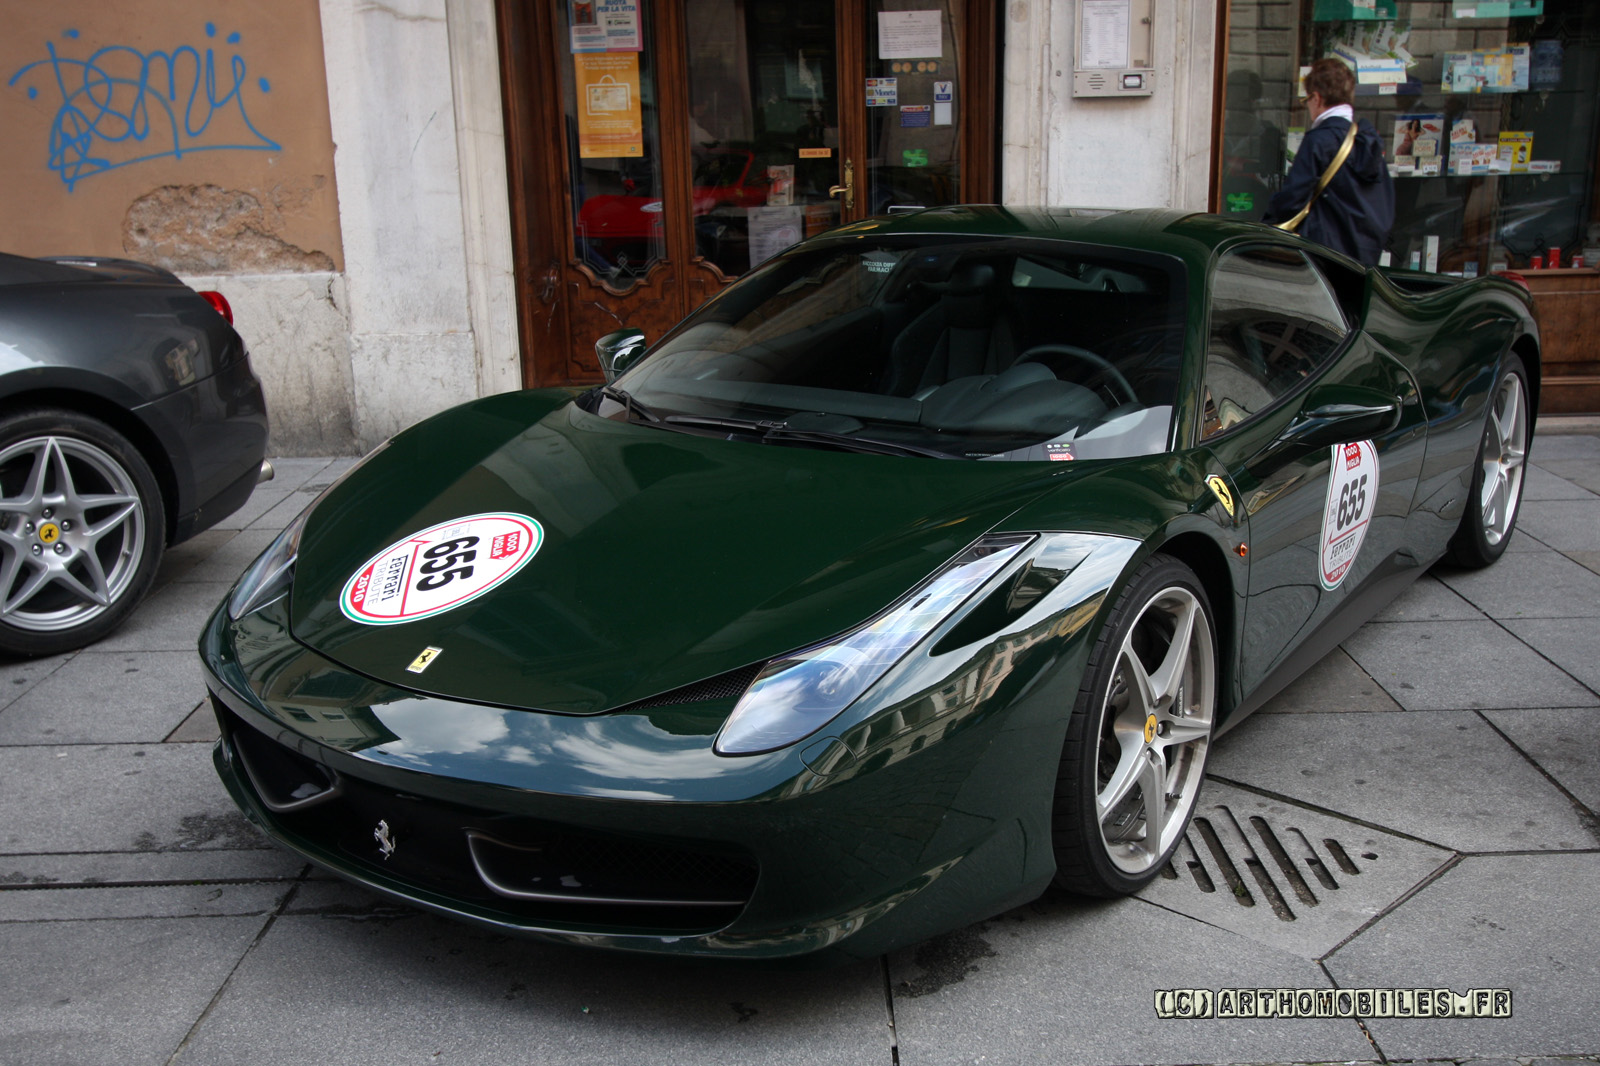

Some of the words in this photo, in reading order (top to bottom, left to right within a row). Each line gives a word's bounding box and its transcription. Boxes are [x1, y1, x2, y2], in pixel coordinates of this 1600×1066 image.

[1346, 445, 1358, 456] 1000
[1337, 473, 1368, 531] 655
[506, 533, 518, 551] 1000
[416, 536, 480, 591] 655
[1329, 549, 1353, 570] TRIBUTE
[1330, 564, 1346, 580] 2010
[353, 574, 370, 603] 2010
[367, 560, 389, 606] TRIBUTE
